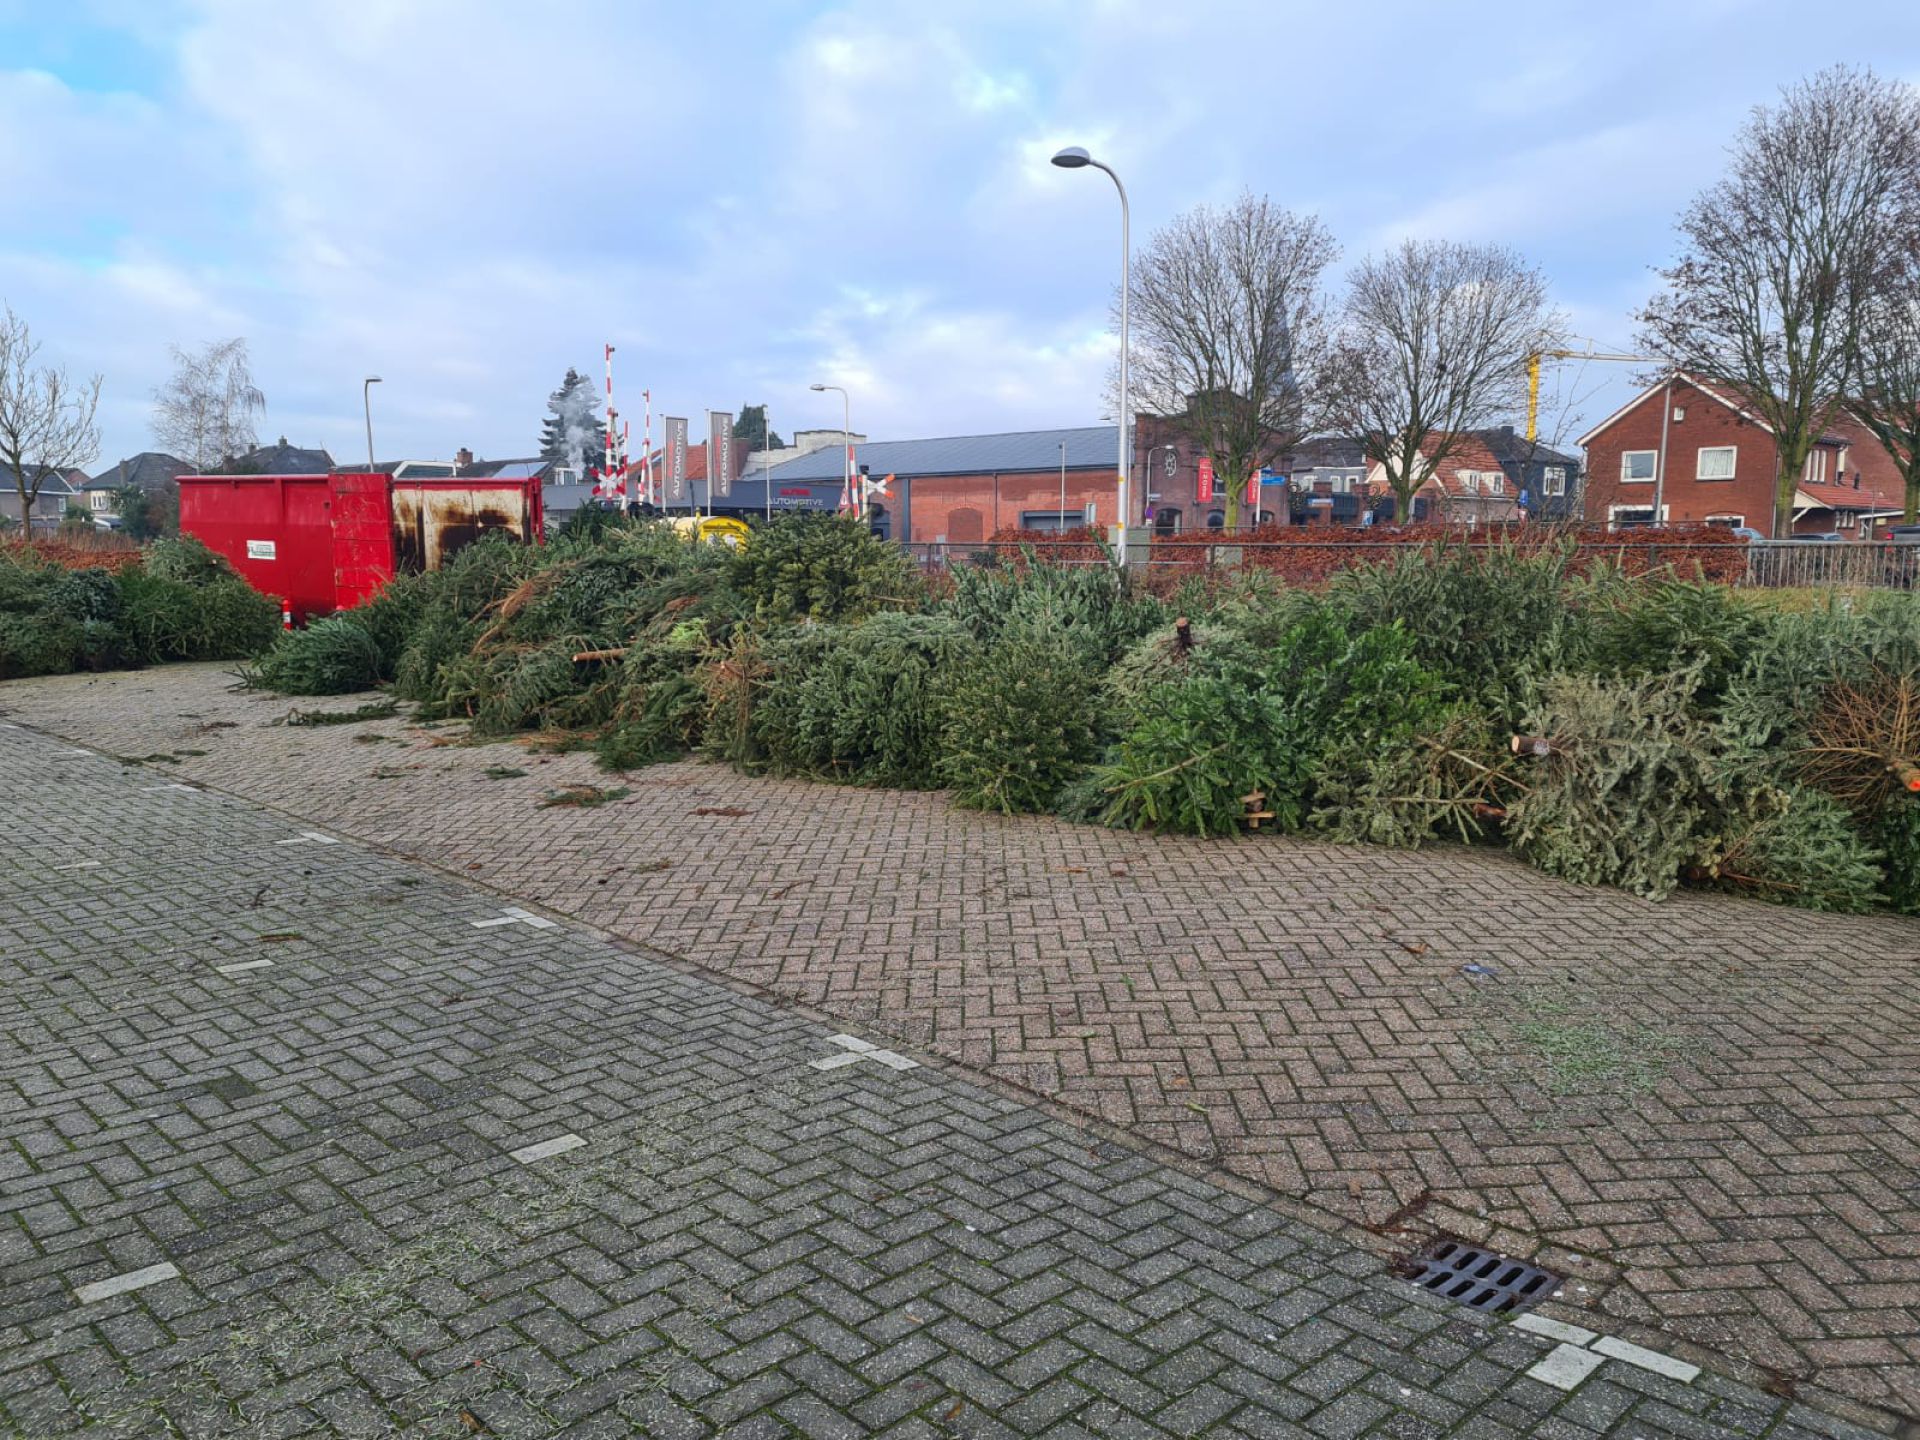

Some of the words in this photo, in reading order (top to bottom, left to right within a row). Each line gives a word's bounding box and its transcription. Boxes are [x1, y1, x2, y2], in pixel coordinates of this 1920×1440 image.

[672, 422, 684, 497] AUTOMOTIVE
[720, 416, 730, 494] AUTOMOTIVE
[766, 497, 824, 506] AUTOMOTIVE
